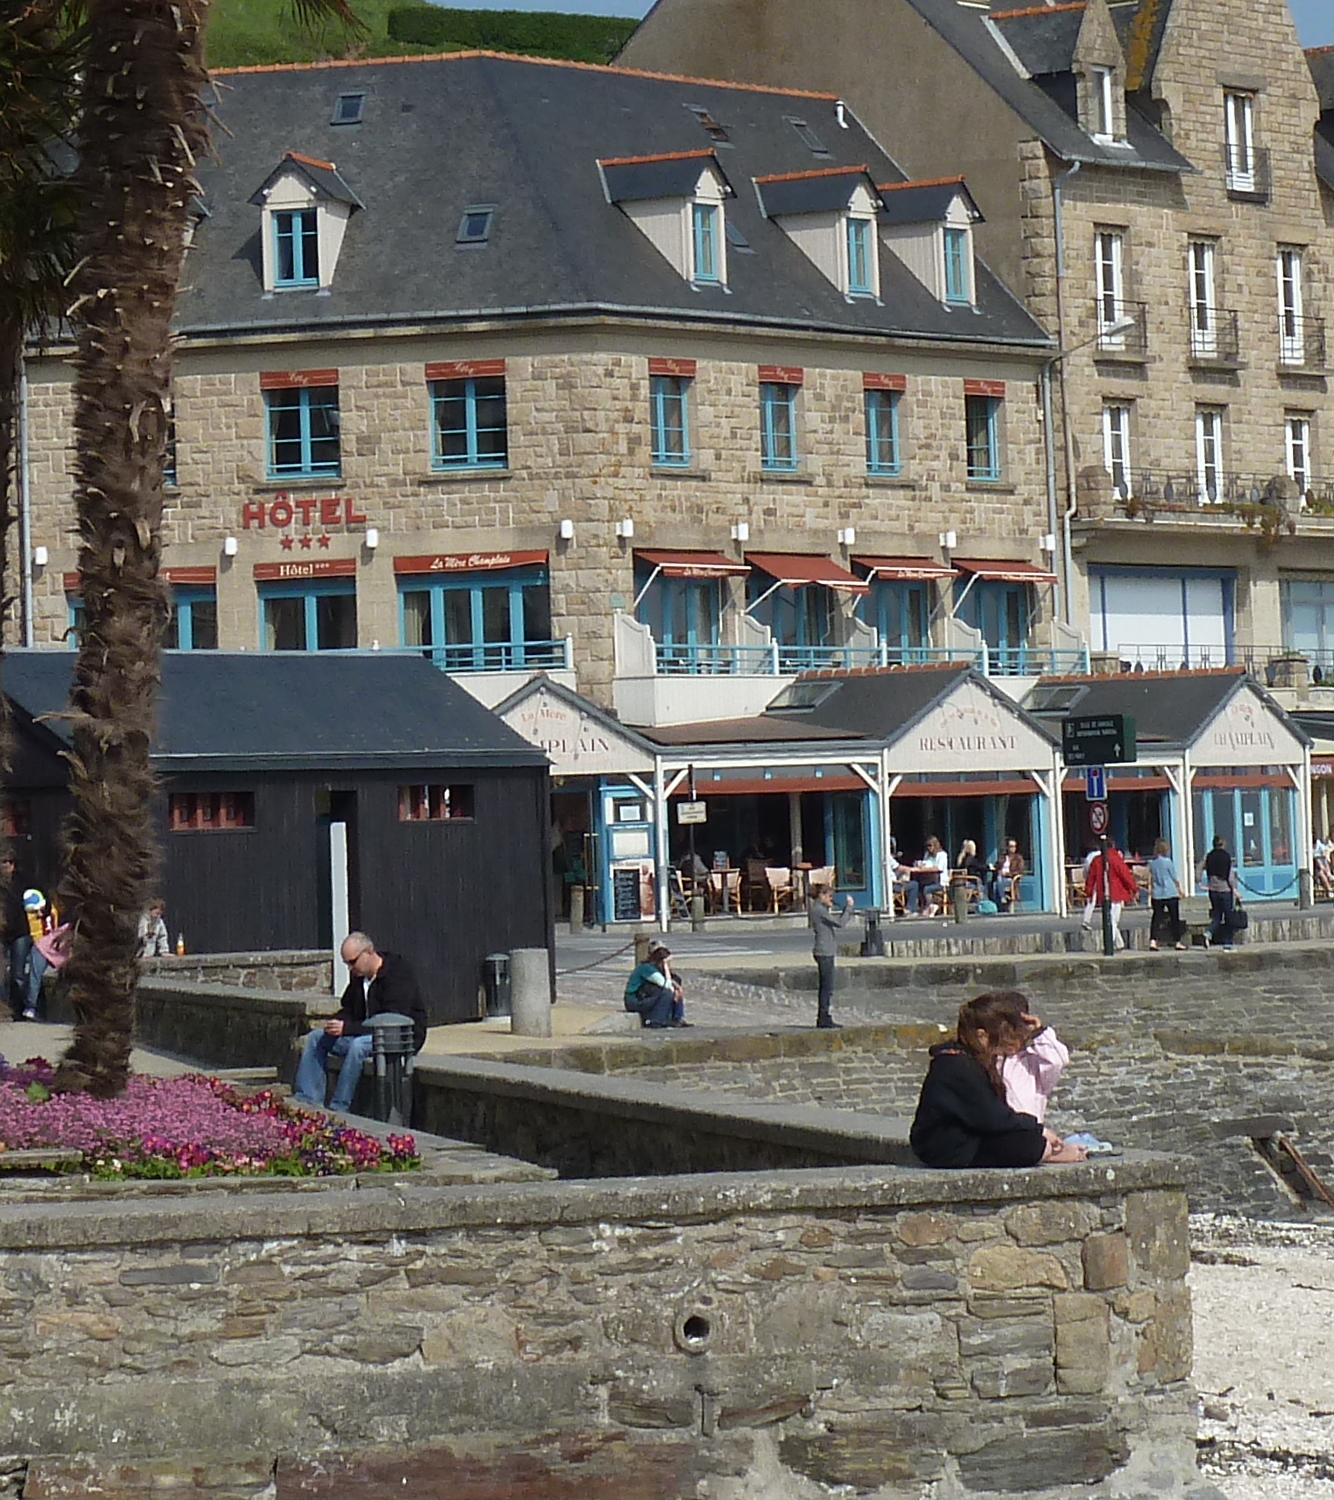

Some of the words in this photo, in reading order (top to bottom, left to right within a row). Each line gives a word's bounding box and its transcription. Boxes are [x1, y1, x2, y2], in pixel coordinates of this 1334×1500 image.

[242, 490, 367, 529] HÔTEL
[279, 564, 313, 576] Hôtel
[540, 738, 609, 753] PLAIN
[919, 735, 1016, 751] RESTAURANT
